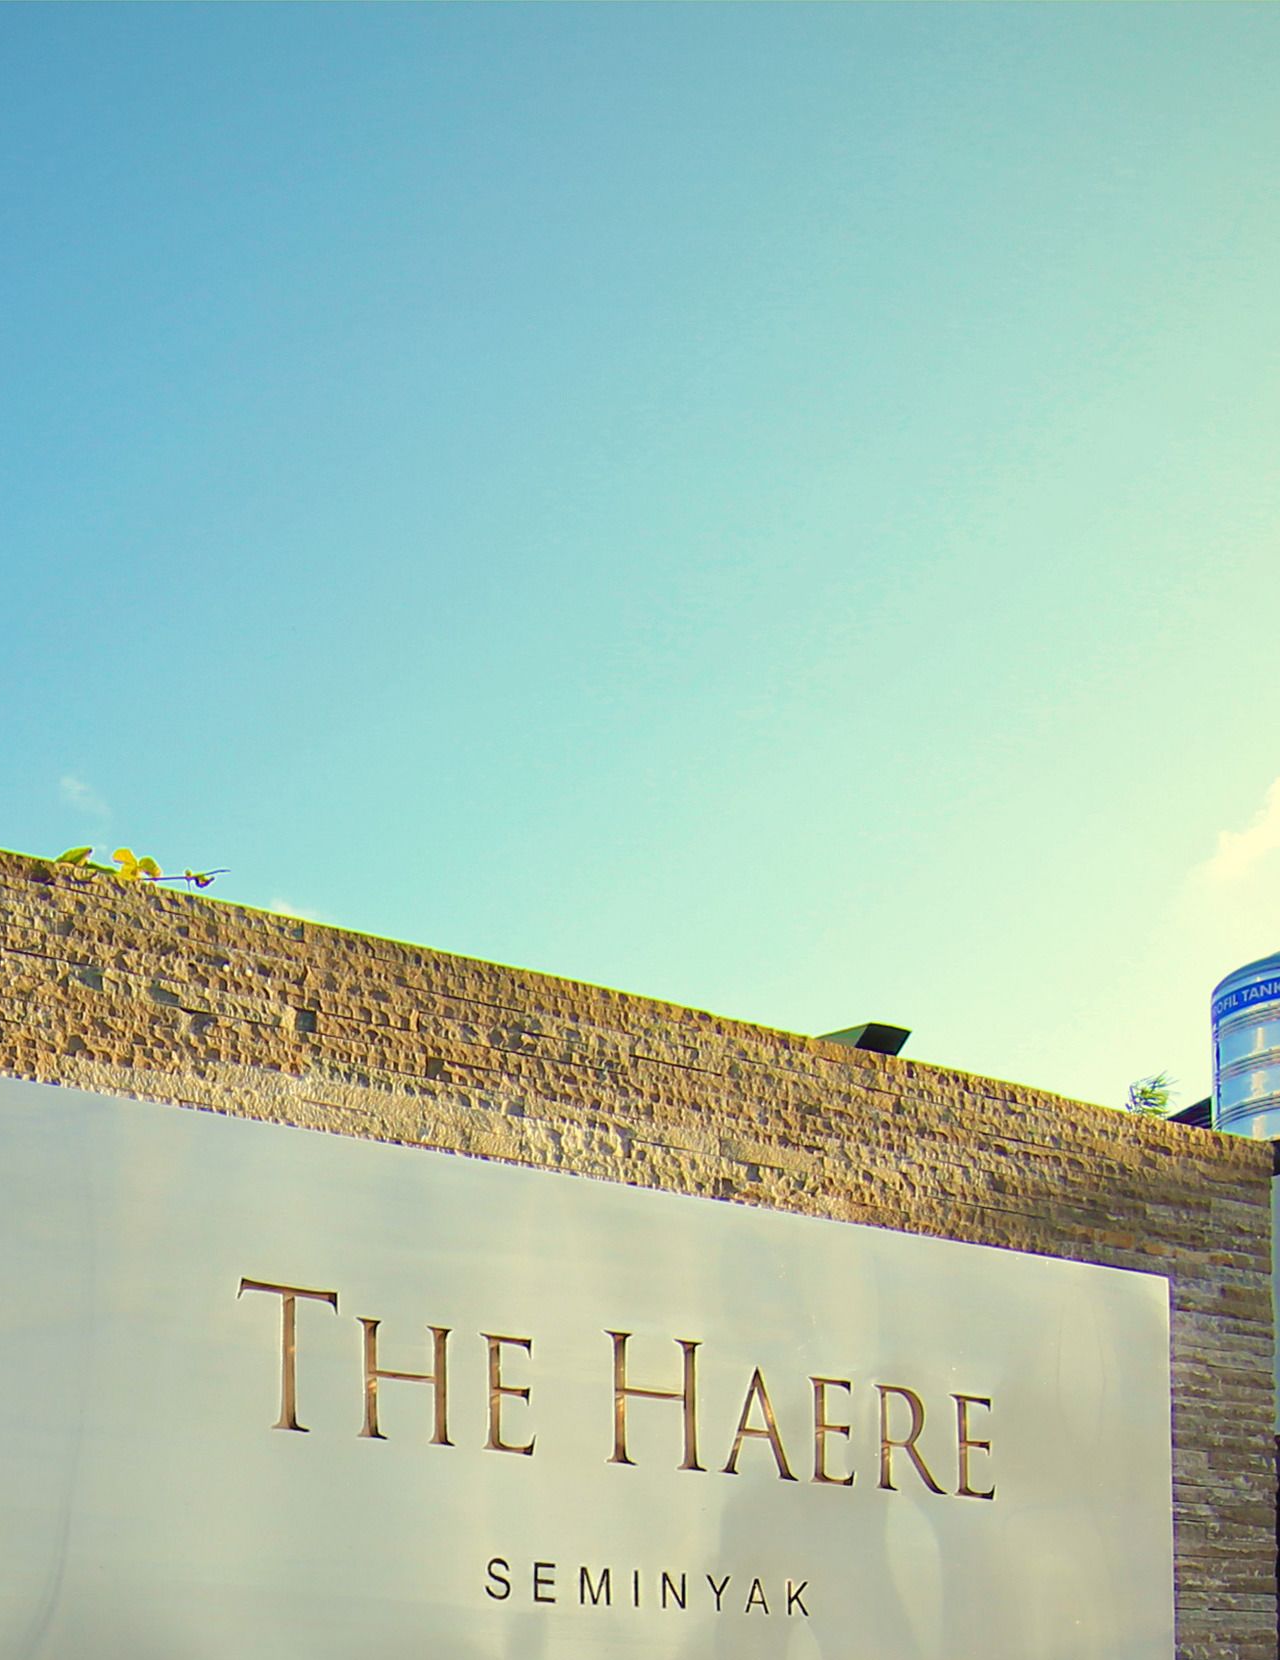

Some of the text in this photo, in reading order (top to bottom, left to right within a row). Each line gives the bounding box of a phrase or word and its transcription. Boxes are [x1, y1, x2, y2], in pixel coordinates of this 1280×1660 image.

[237, 1277, 996, 1500] THE HAERE
[484, 1557, 811, 1617] SEMINYAK
